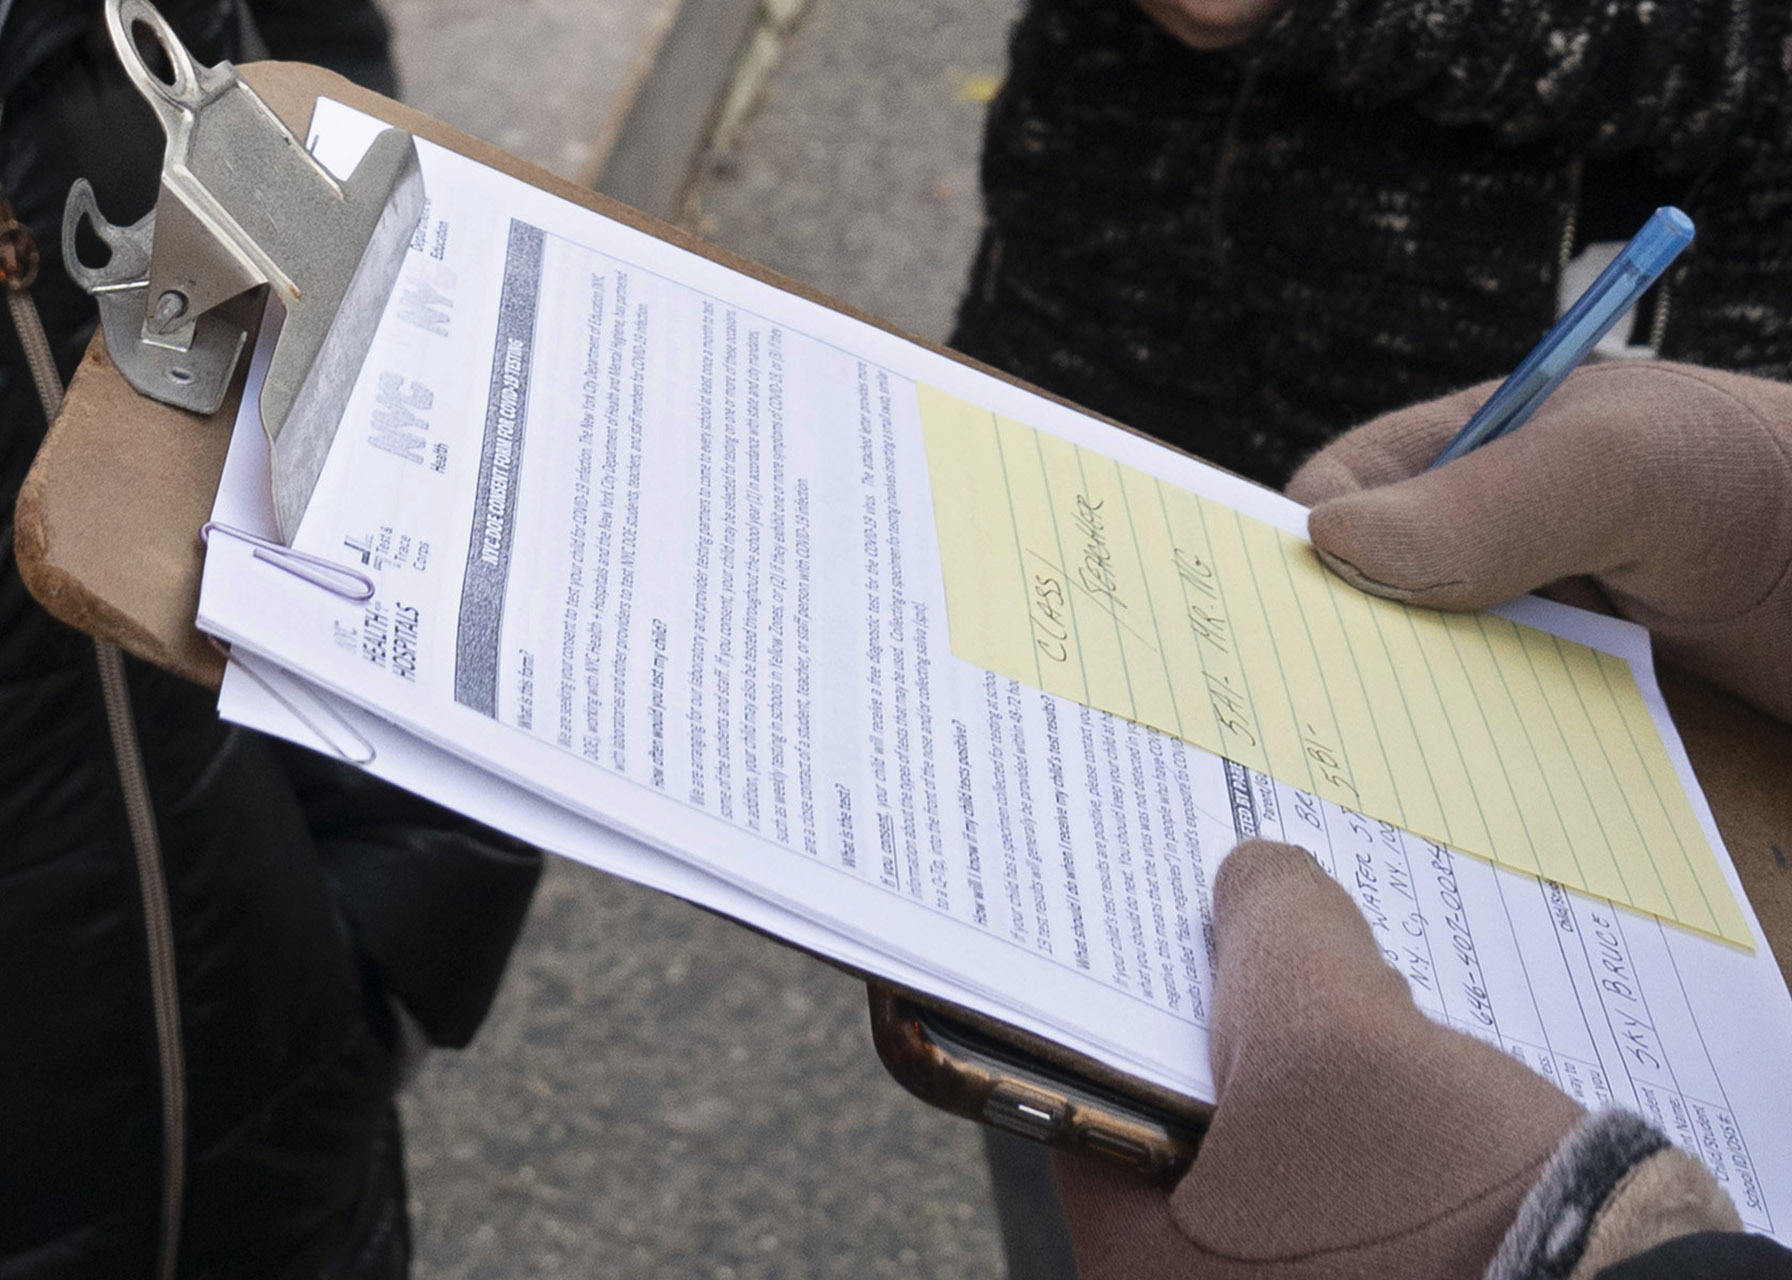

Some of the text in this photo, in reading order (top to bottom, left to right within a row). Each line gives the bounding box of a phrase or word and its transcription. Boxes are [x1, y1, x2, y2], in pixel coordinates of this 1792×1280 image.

[430, 221, 448, 260] Education
[430, 442, 448, 474] Health
[480, 336, 524, 567] NYC DOE CONSENT FORM FOR COVID-19 TESTING
[794, 476, 808, 515] infection.
[395, 535, 411, 563] Trace
[795, 514, 809, 559] COVID-19
[413, 541, 429, 571] Corps
[796, 557, 808, 581] with
[798, 581, 809, 618] person
[911, 598, 927, 628] (spit).
[363, 608, 389, 669] HEALTH
[392, 601, 421, 683] HOSPITALS
[652, 617, 666, 651] child?
[795, 615, 807, 641] staff
[913, 626, 927, 656] saliva
[651, 668, 663, 690] test
[796, 653, 809, 697] teacher,
[914, 654, 932, 702] collecting
[652, 689, 665, 710] you
[1040, 693, 1057, 734] results?
[1077, 701, 1094, 727] your
[649, 707, 662, 739] would
[795, 696, 810, 740] student,
[916, 699, 932, 735] and/or
[649, 737, 663, 766] often
[922, 734, 933, 760] nose
[952, 718, 970, 767] positive?
[1047, 733, 1060, 755] test
[1080, 726, 1095, 763] contact
[1101, 734, 1117, 760] child
[650, 765, 663, 788] How
[799, 760, 811, 800] contact
[921, 759, 934, 778] the
[957, 765, 971, 792] tests
[1083, 762, 1101, 797] please
[1108, 760, 1124, 786] your
[1126, 745, 1144, 791] detected
[835, 782, 850, 811] test?
[922, 788, 937, 816] front
[958, 790, 973, 817] child
[1109, 783, 1126, 811] keep
[1134, 790, 1147, 810] not
[799, 799, 813, 828] close
[837, 809, 851, 830] the
[927, 815, 940, 834] the
[1056, 806, 1070, 844] receive
[1089, 796, 1107, 842] positive,
[1112, 809, 1128, 846] should
[1138, 809, 1150, 832] was
[804, 835, 816, 855] are
[840, 838, 855, 868] What
[929, 833, 942, 856] into
[965, 842, 980, 873] know
[1095, 840, 1107, 859] are
[1117, 845, 1131, 867] You
[1138, 830, 1154, 859] virus
[929, 854, 947, 889] Q-Tip,
[1059, 849, 1075, 880] when
[1095, 857, 1112, 895] results
[1143, 858, 1156, 878] the
[968, 878, 983, 900] will
[1122, 868, 1136, 895] next.
[1145, 876, 1160, 902] that
[1356, 853, 1390, 931] WATER
[972, 899, 987, 926] How
[1067, 900, 1085, 939] should
[1102, 894, 1116, 916] test
[1151, 901, 1166, 937] means
[1126, 909, 1144, 947] should
[1072, 937, 1090, 971] What
[1135, 947, 1151, 970] you
[1154, 936, 1170, 960] this
[1591, 912, 1636, 1002] BRUCE
[1112, 950, 1129, 979] your
[1136, 968, 1153, 998] what
[1160, 959, 1183, 1012] negative,
[1692, 1104, 1729, 1181] Child/Student
[1738, 1169, 1762, 1211] School
